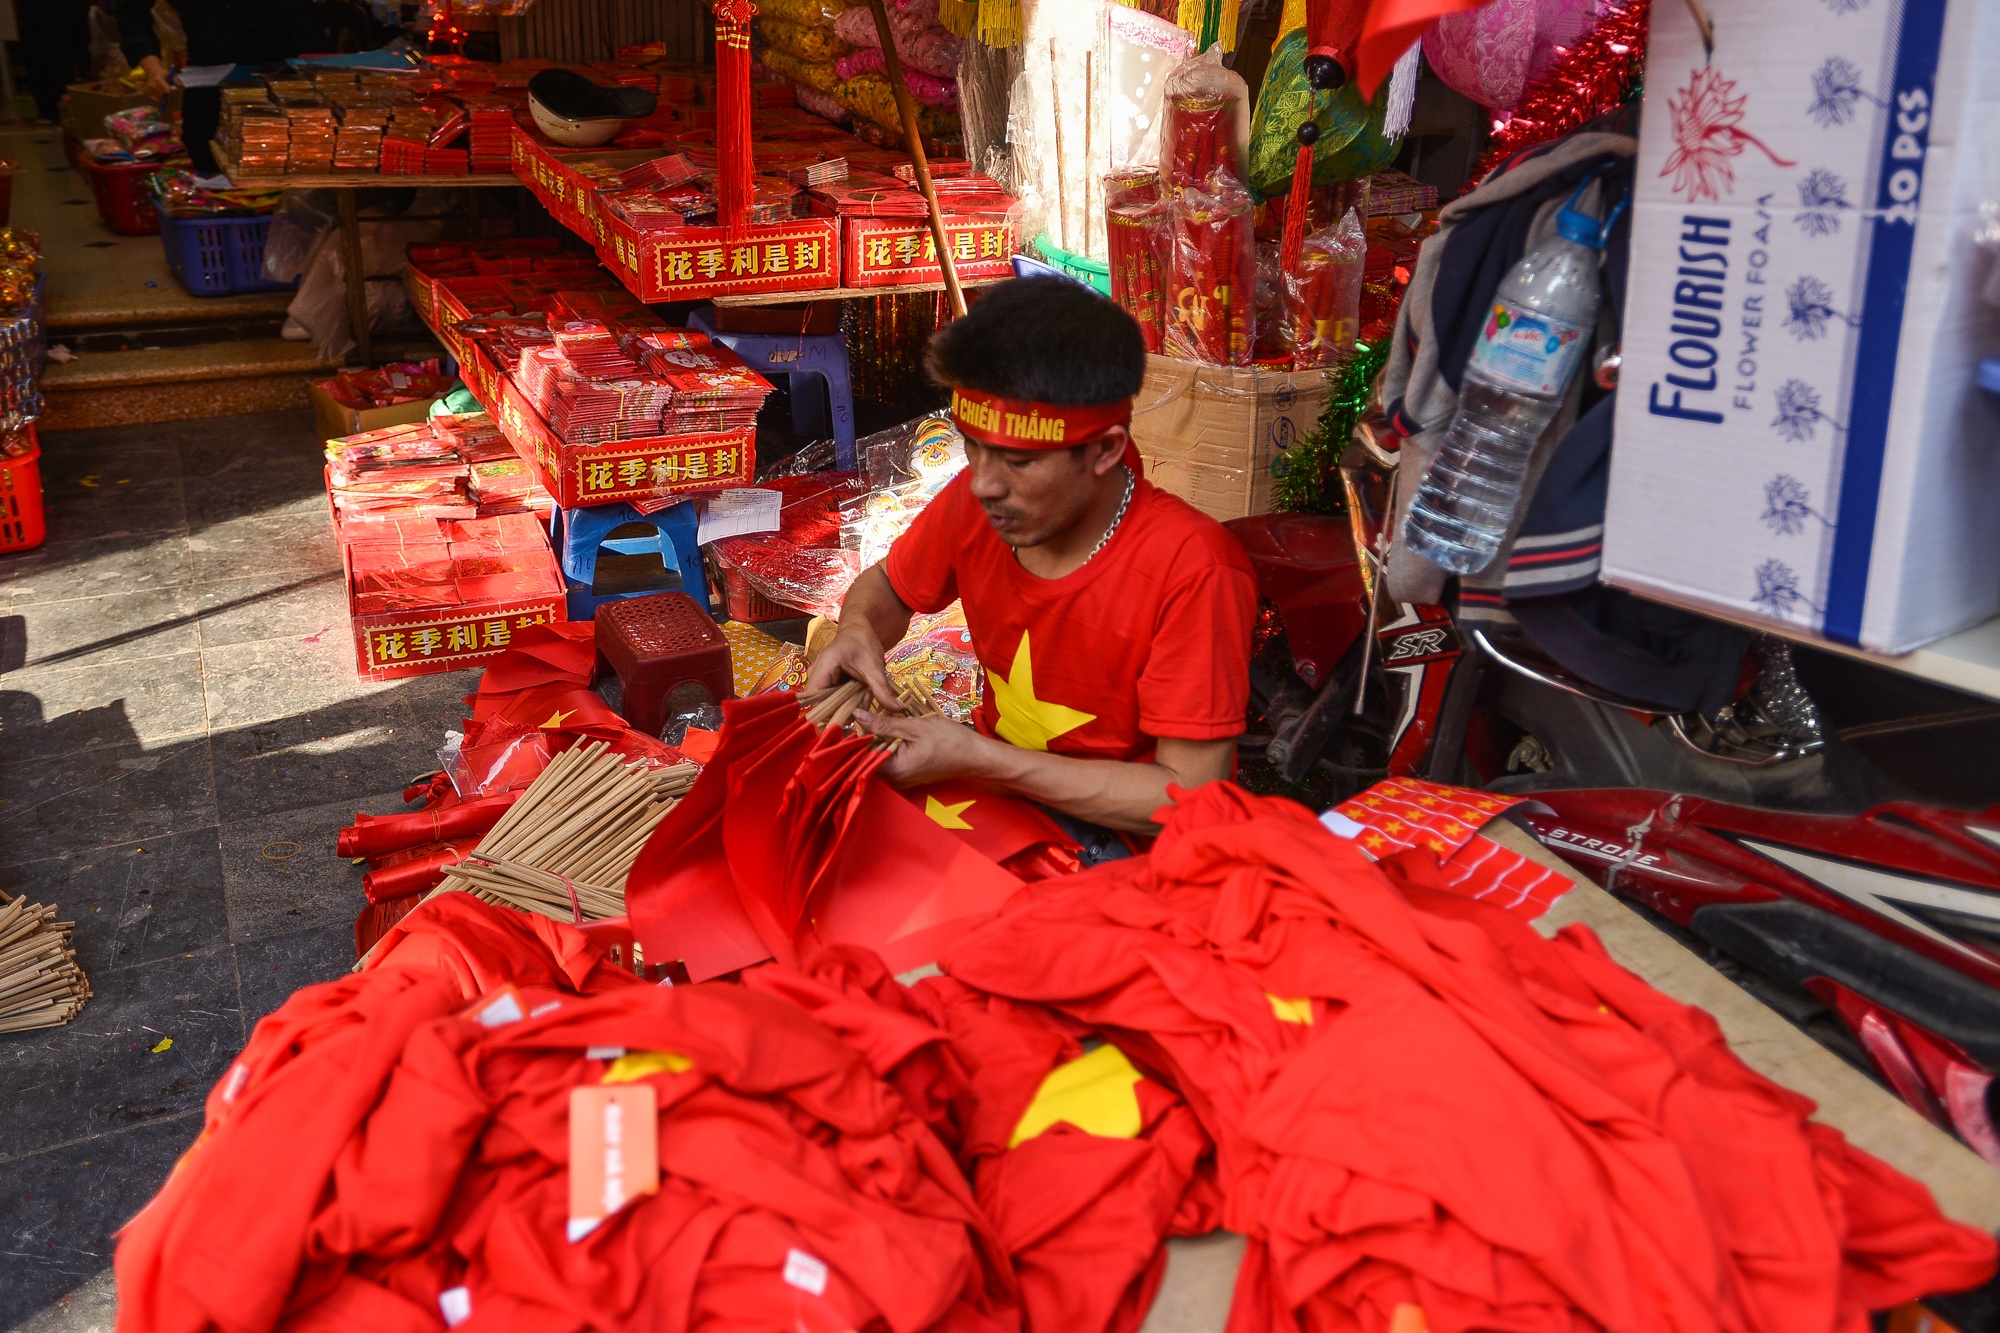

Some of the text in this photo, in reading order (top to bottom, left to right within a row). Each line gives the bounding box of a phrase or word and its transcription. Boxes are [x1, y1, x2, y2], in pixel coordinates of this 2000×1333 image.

[1892, 87, 1929, 160] PCS
[664, 240, 821, 281] 花季利是封
[1649, 215, 1732, 424] FLOURISH
[1734, 295, 1764, 410] FLOWER
[960, 397, 1001, 433] CHIẾN
[1005, 409, 1065, 441] THẮNG
[585, 447, 739, 491] 花季利是封
[1389, 628, 1448, 660] SR
